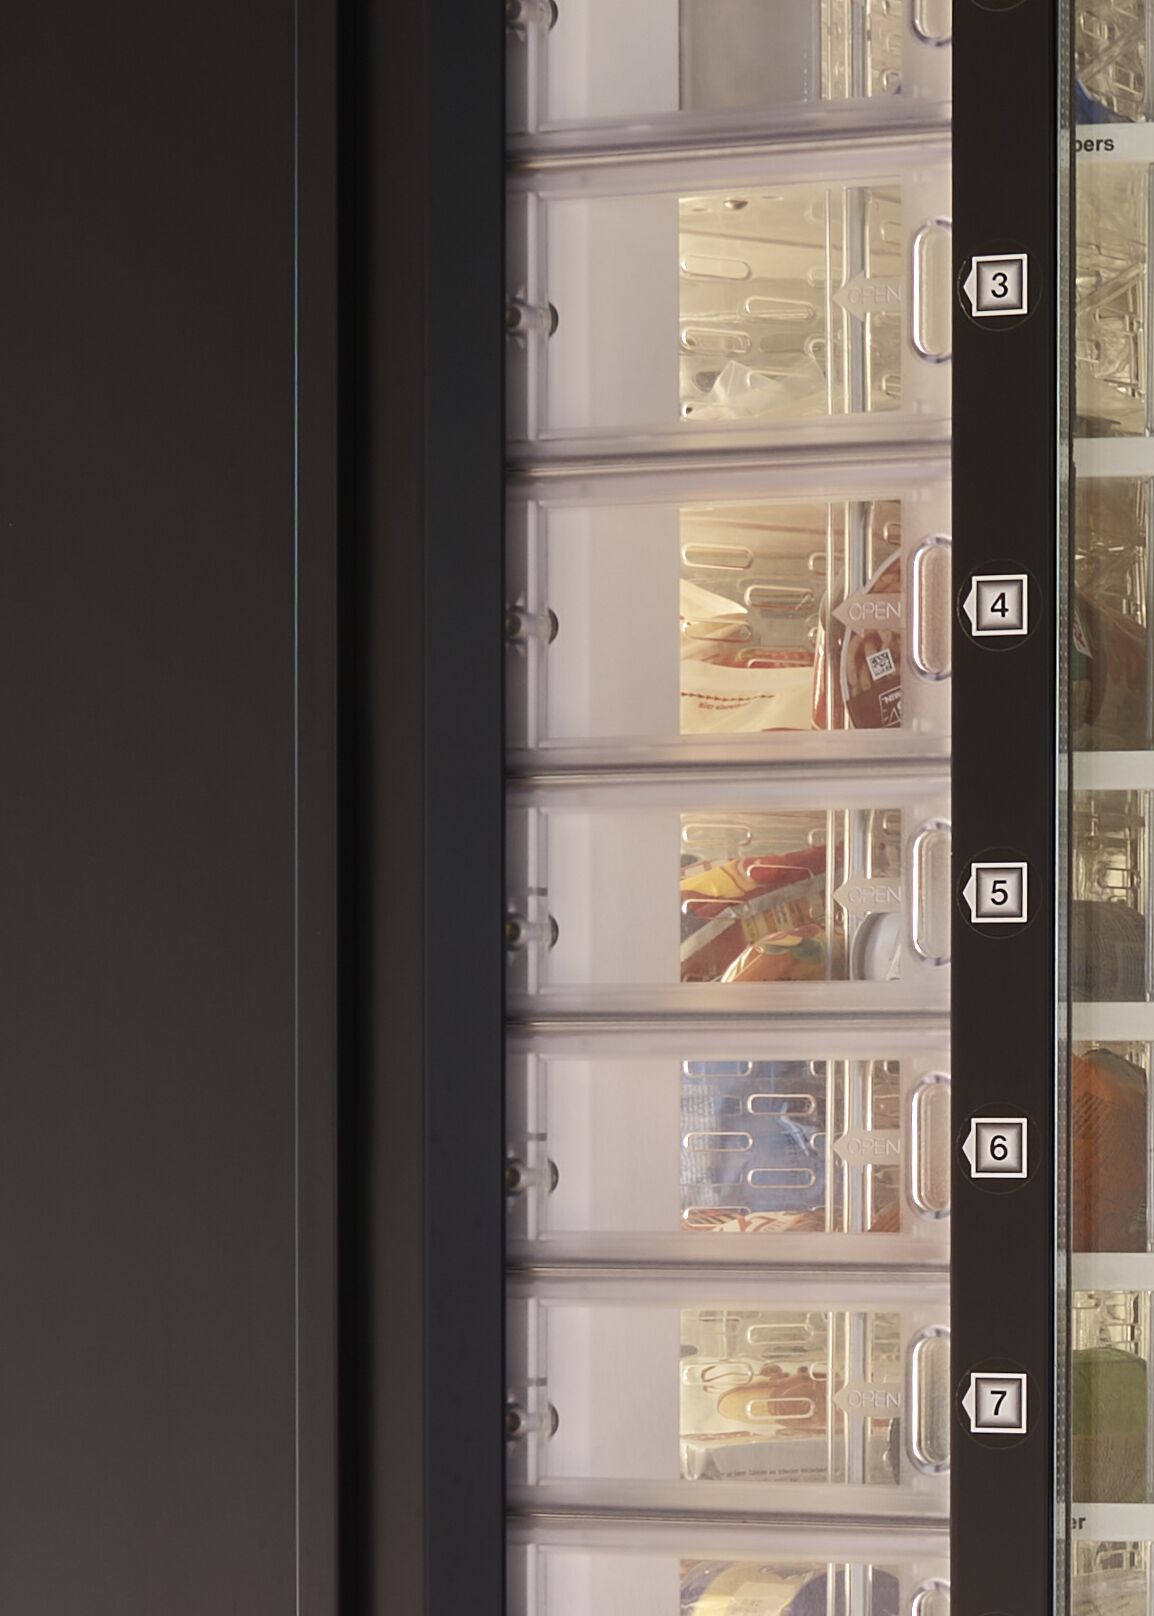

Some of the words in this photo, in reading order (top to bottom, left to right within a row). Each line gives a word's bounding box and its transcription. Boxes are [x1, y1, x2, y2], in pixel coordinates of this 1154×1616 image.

[848, 285, 902, 304] OPEN
[990, 273, 1009, 298] 3
[849, 601, 902, 621] OPEN
[990, 592, 1009, 618] 4
[848, 886, 901, 904] OPEN
[990, 881, 1009, 906] 5
[847, 1138, 901, 1155] OPEN
[989, 1135, 1008, 1161] 6
[848, 1391, 902, 1409] OPEN
[990, 1391, 1007, 1416] 7
